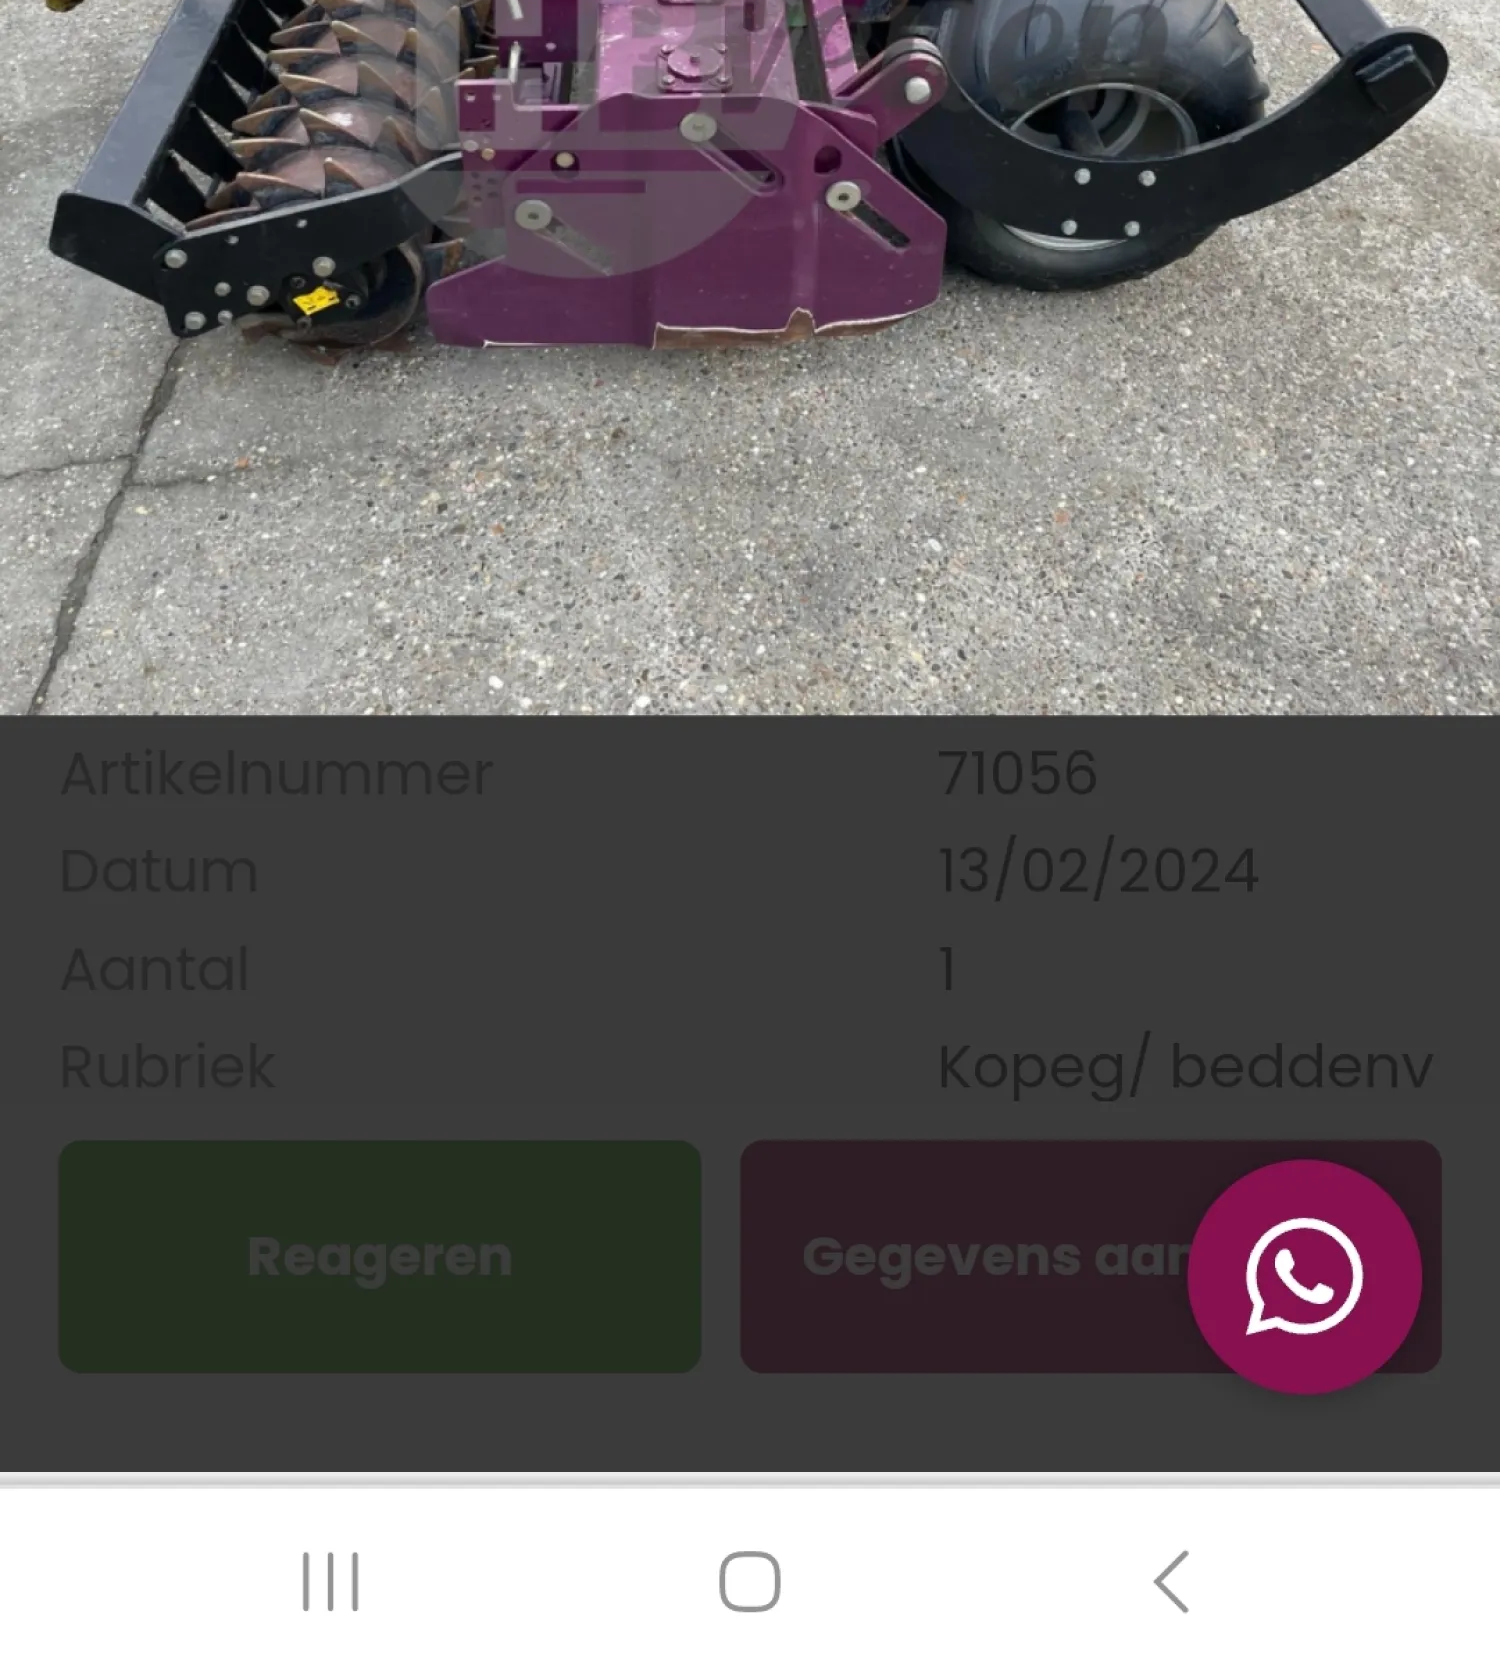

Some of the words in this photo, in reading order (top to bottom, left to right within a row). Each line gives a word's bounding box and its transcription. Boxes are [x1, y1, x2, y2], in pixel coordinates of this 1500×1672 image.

[60, 748, 494, 796] Artikelnummer
[938, 749, 1097, 796] 71056
[61, 849, 257, 894] Datum
[938, 834, 1259, 902] 13/02/2024
[60, 944, 247, 991] Aantal
[938, 946, 953, 991] 1
[61, 1041, 277, 1089] Rubriek
[941, 1029, 1151, 1102] Kopeg/
[1172, 1042, 1434, 1089] beddenv
[248, 1236, 512, 1290] Reageren
[803, 1236, 1081, 1290] Gegevens
